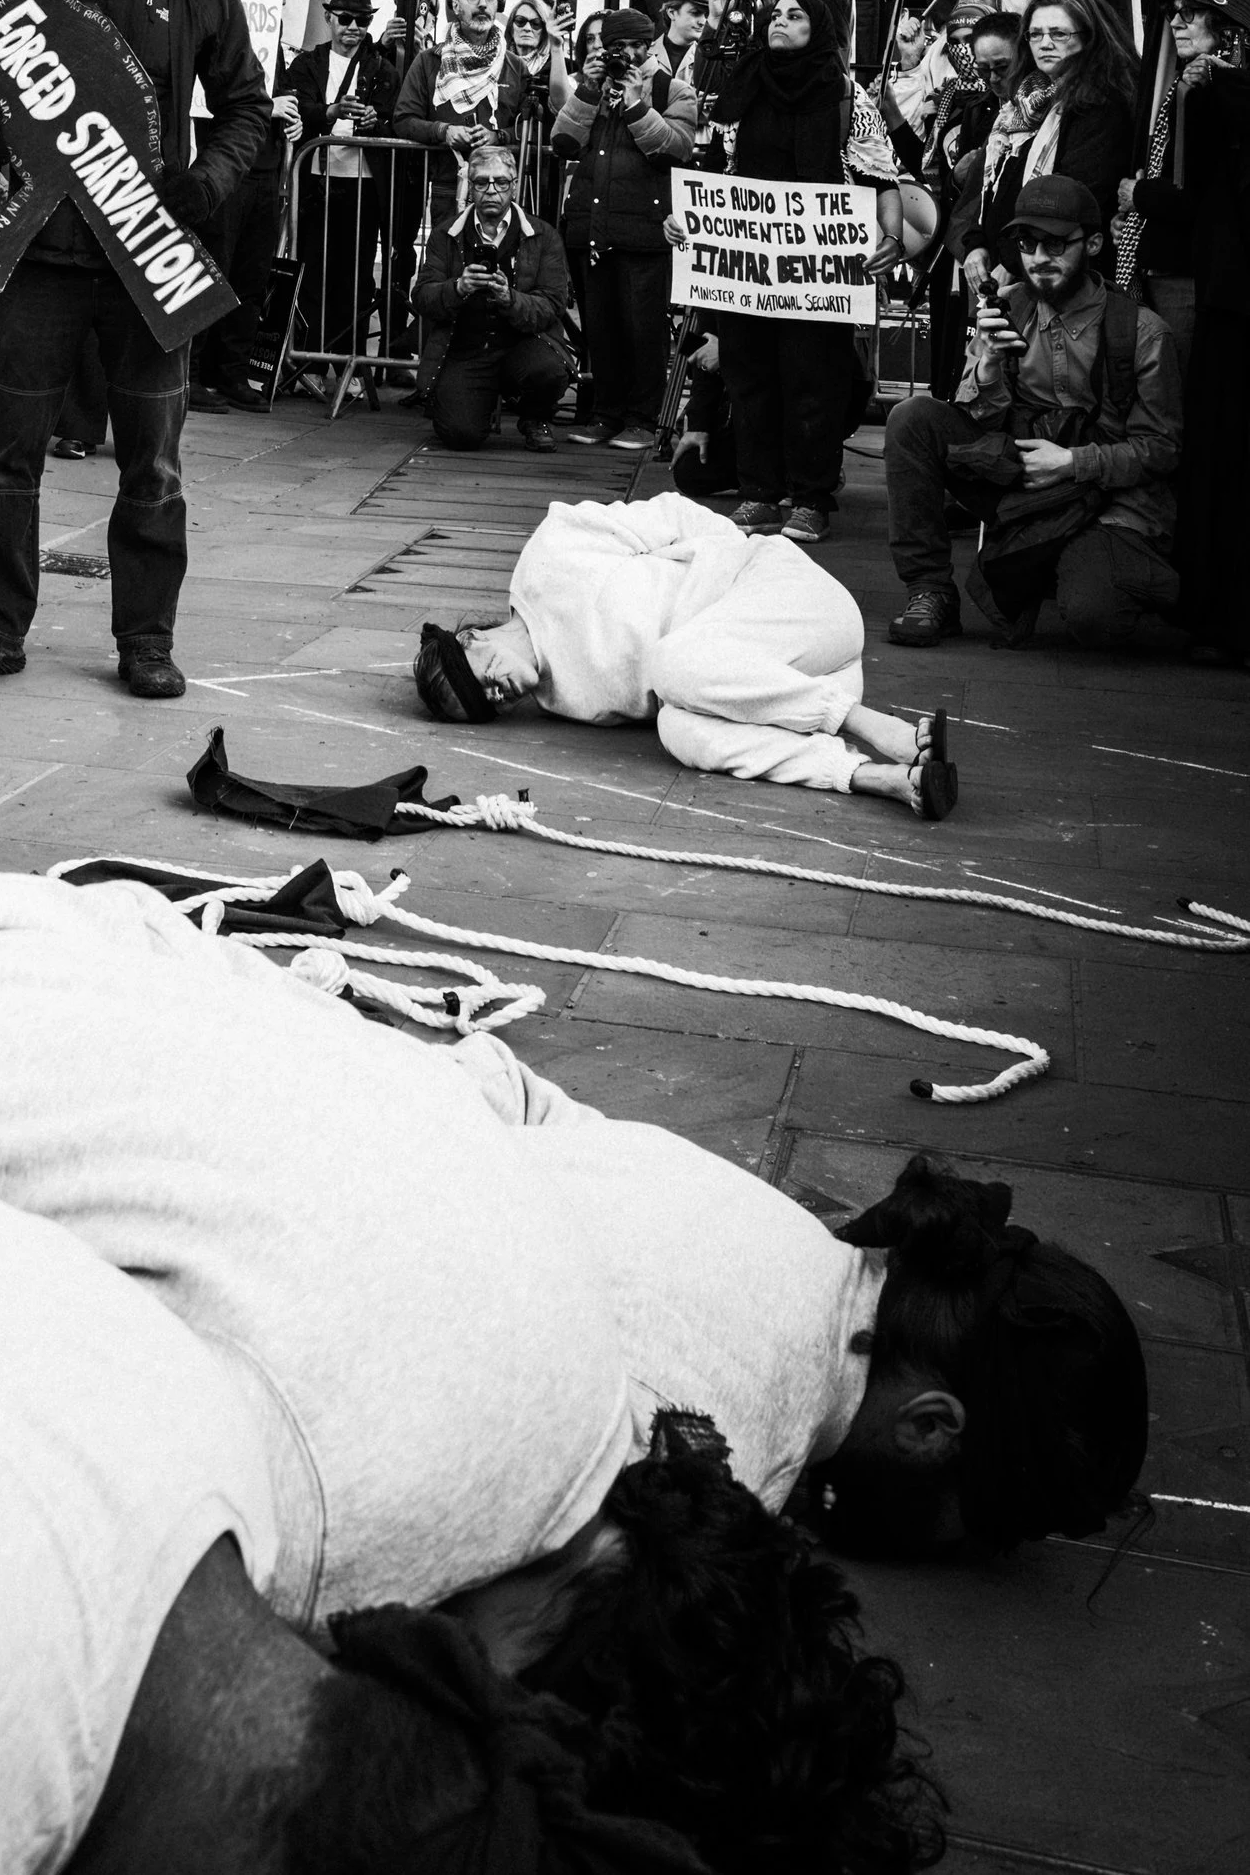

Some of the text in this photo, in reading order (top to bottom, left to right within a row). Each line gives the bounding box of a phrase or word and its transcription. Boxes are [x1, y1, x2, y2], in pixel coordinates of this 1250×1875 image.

[83, 10, 111, 32] FORCED
[122, 55, 148, 90] STARVE
[56, 111, 215, 315] STARVATION
[684, 180, 853, 216] THIS AUDIO IS THE
[684, 210, 869, 246] DOCUMENTED WORDS
[678, 242, 690, 253] OF
[691, 242, 773, 286] ITAMAR
[690, 284, 851, 315] MINISTER OF NATIONAL SECURITY
